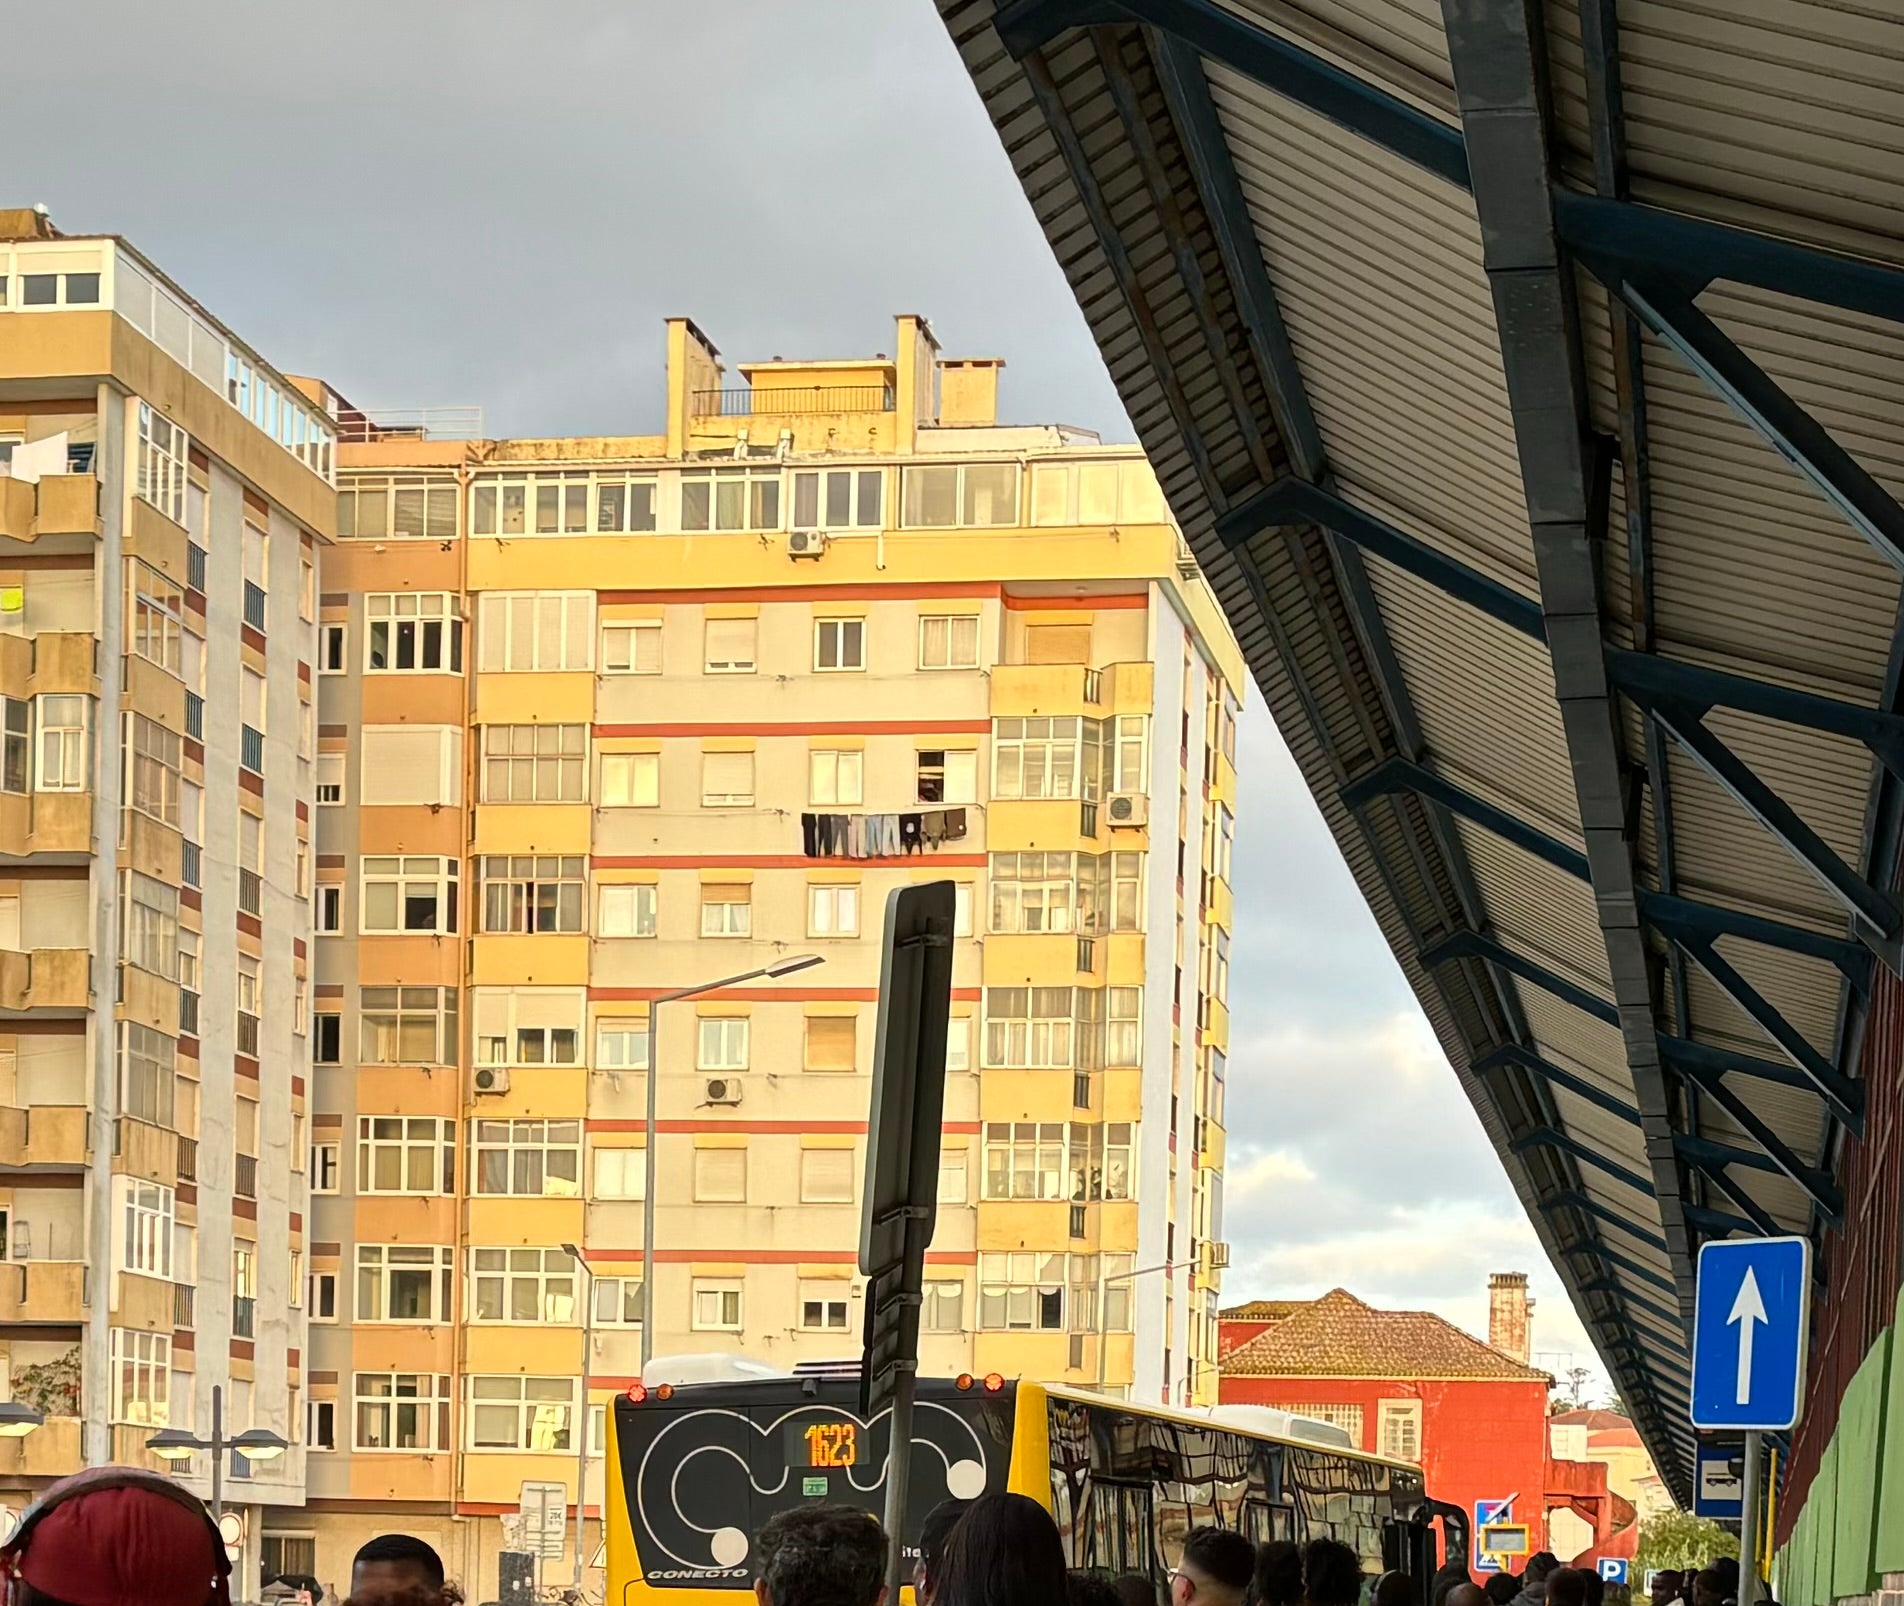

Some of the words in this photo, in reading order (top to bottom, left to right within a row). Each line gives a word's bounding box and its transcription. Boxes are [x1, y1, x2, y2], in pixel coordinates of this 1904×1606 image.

[804, 1423, 856, 1467] 1623
[647, 1568, 749, 1579] CONECTO
[1602, 1561, 1621, 1582] P
